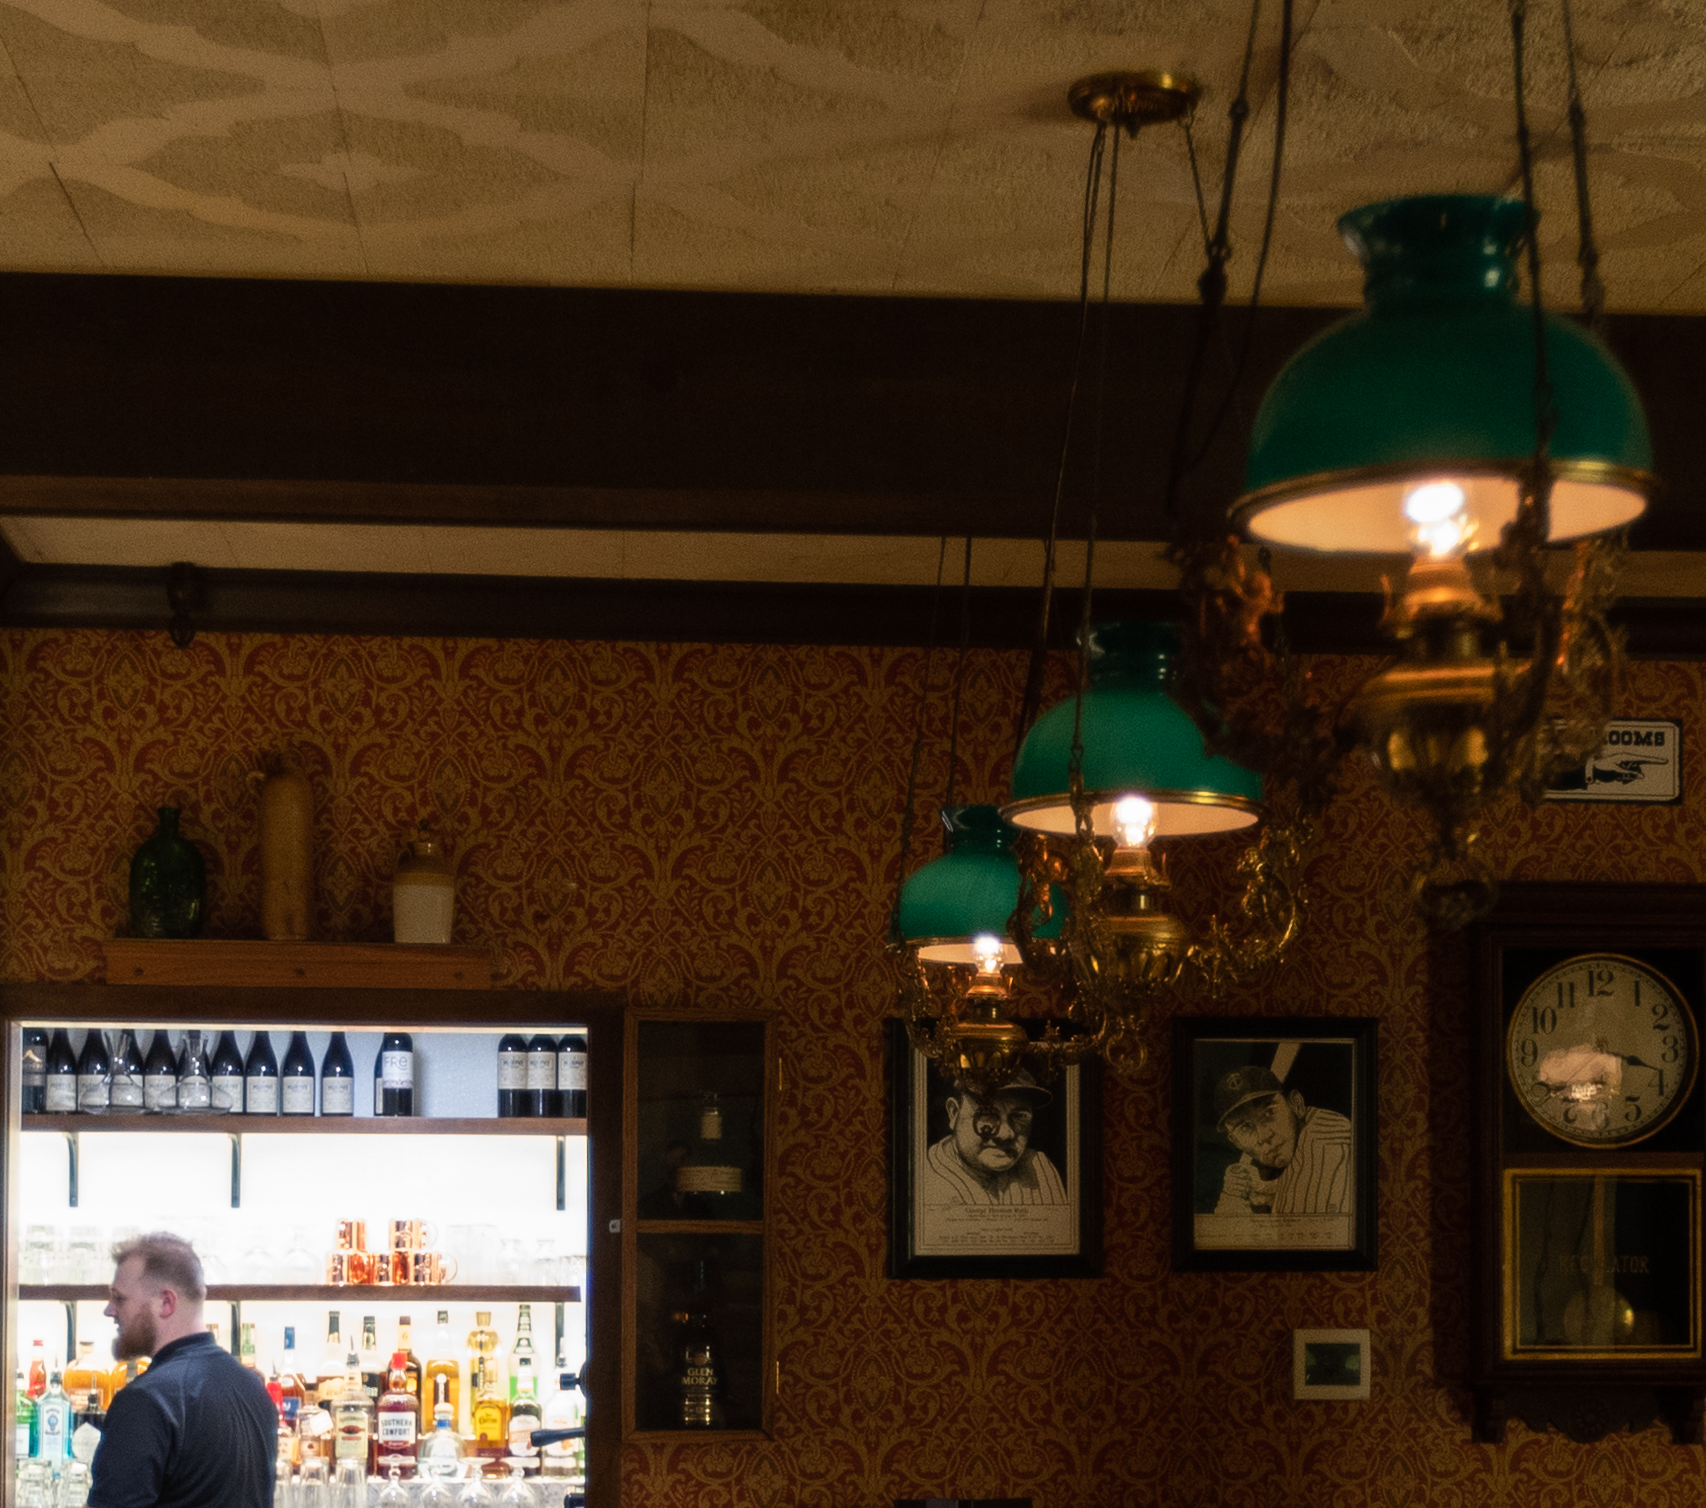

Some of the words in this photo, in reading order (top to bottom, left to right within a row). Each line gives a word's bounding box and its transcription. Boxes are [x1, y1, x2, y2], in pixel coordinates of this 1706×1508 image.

[1604, 730, 1666, 747] OOMS
[1557, 981, 1576, 1008] 11
[1587, 969, 1614, 997] 12
[1634, 980, 1641, 1007] 1
[1532, 1006, 1557, 1034] 10
[1652, 1003, 1670, 1031] 2
[1521, 1038, 1538, 1067] 9
[1661, 1035, 1679, 1063] 3
[1648, 1069, 1669, 1097] 4
[1625, 1096, 1642, 1122] 5
[1558, 1255, 1650, 1274] REGATOR
[681, 1376, 718, 1385] MORAY
[687, 1367, 714, 1376] GLEN
[381, 1418, 412, 1427] SOUTHERN
[382, 1428, 410, 1436] COMFORT
